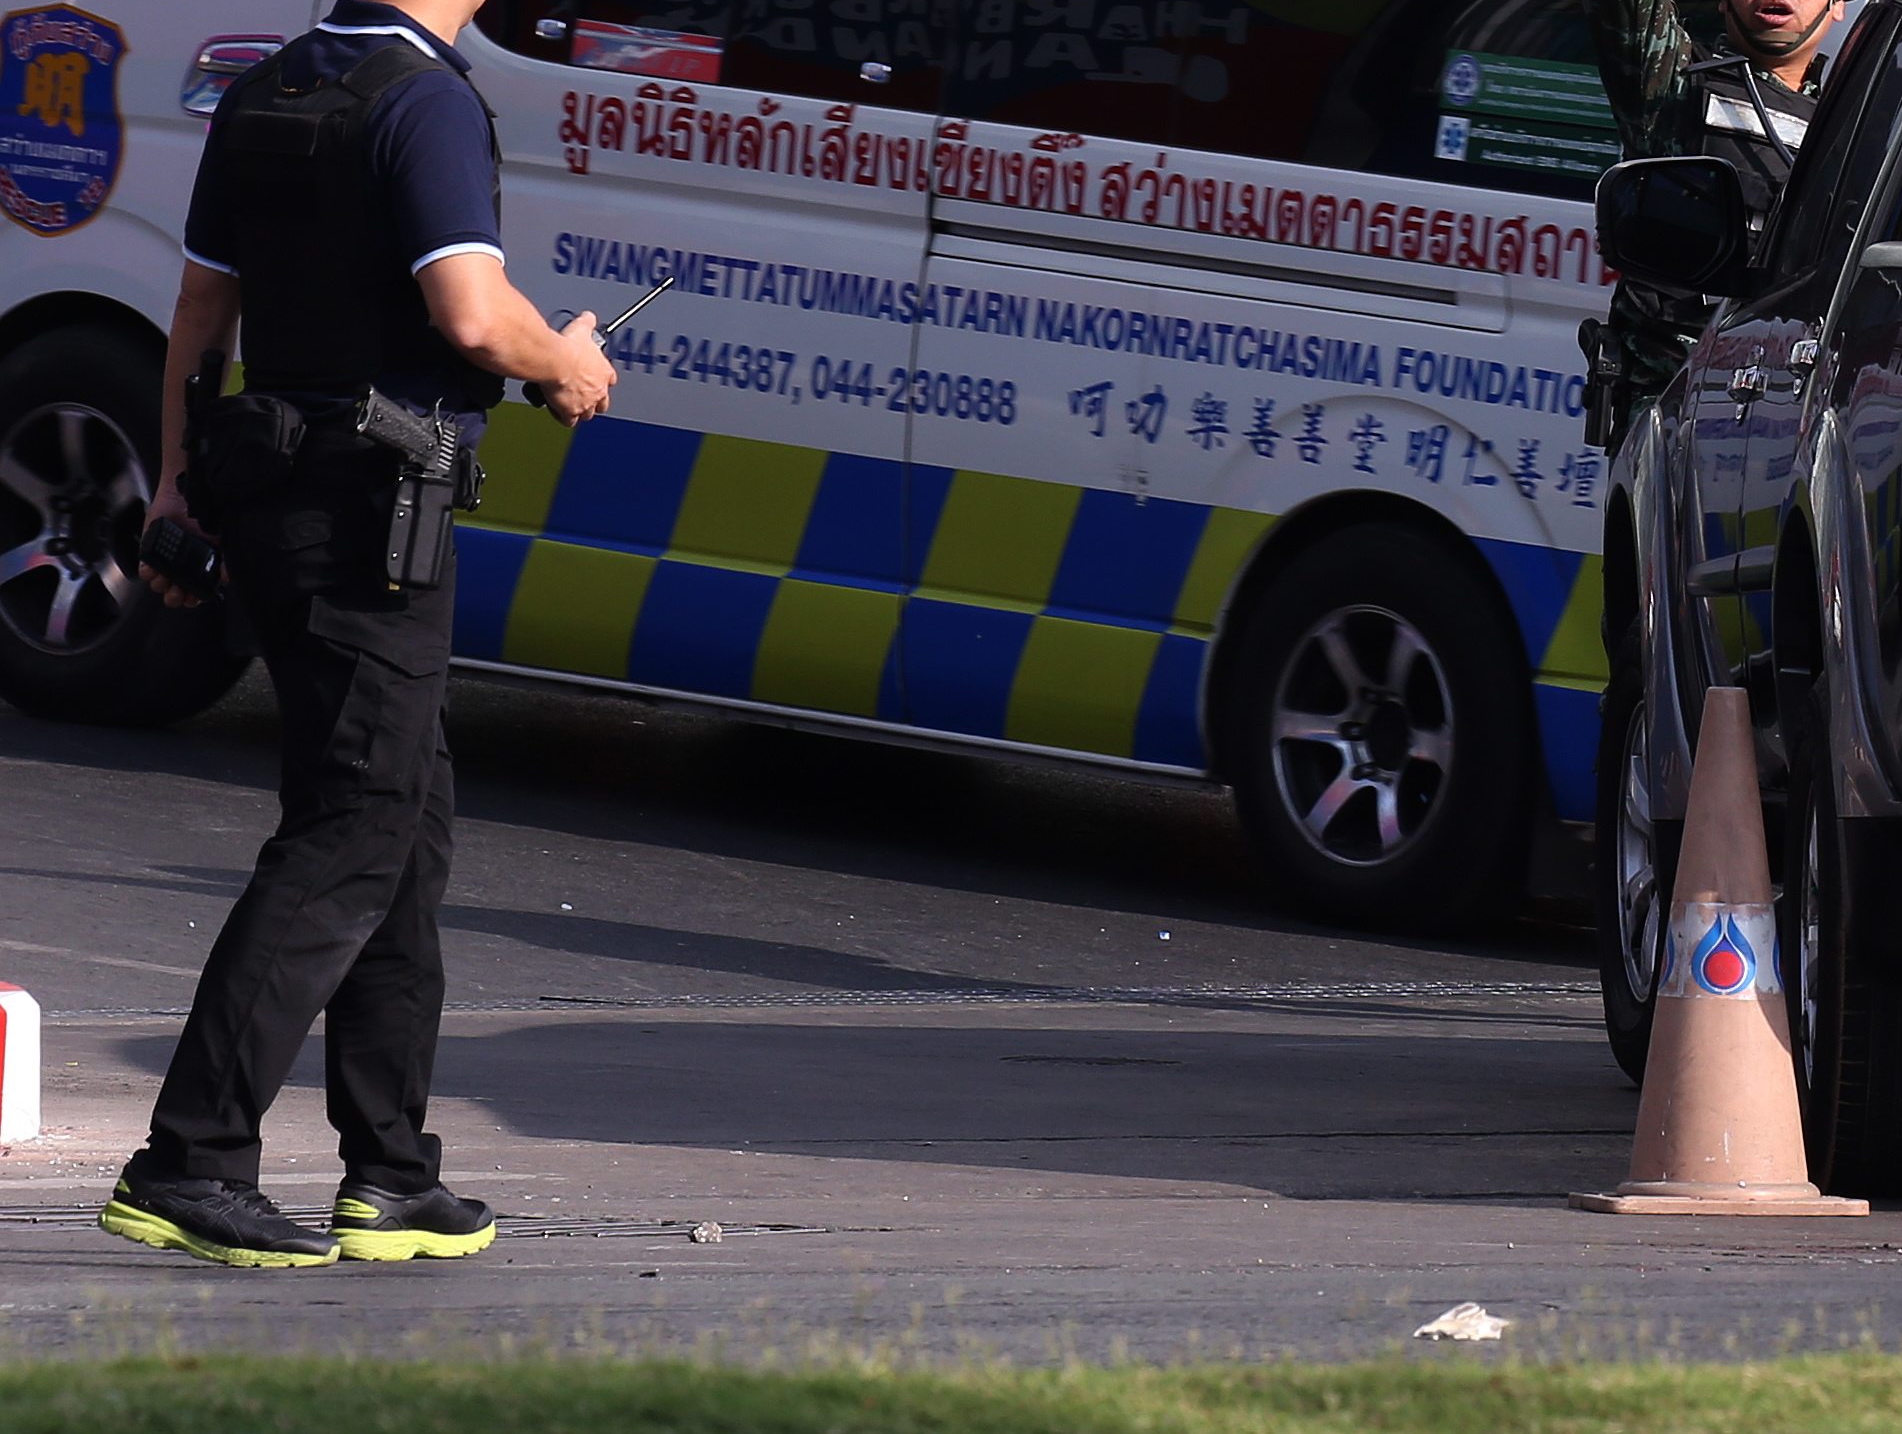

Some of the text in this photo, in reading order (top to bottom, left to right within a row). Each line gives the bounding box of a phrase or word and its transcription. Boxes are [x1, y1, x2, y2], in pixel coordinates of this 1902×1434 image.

[553, 231, 1588, 419] SWANGMETTATUMMASATARN NAKORNRATCHASIMA FOUNDATIO
[811, 353, 1019, 427] 044-230888
